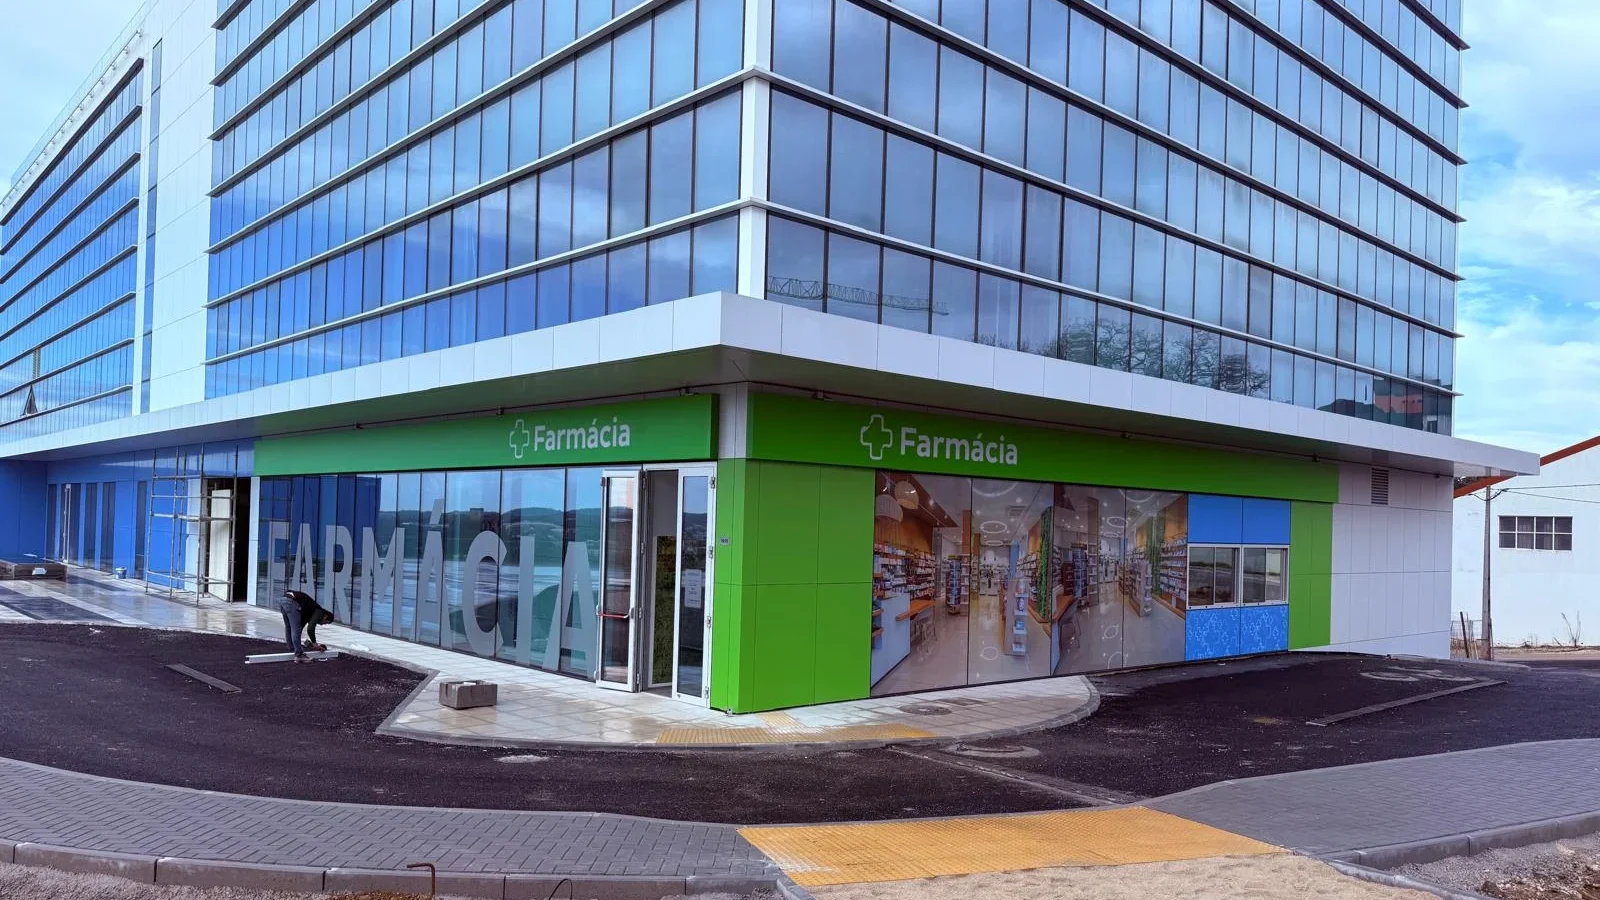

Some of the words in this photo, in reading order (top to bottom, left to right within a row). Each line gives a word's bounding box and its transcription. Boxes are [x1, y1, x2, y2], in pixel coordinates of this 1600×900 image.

[534, 416, 630, 451] Farmácia
[900, 427, 1018, 465] Farmácia
[266, 498, 597, 679] FARMÁCIA
